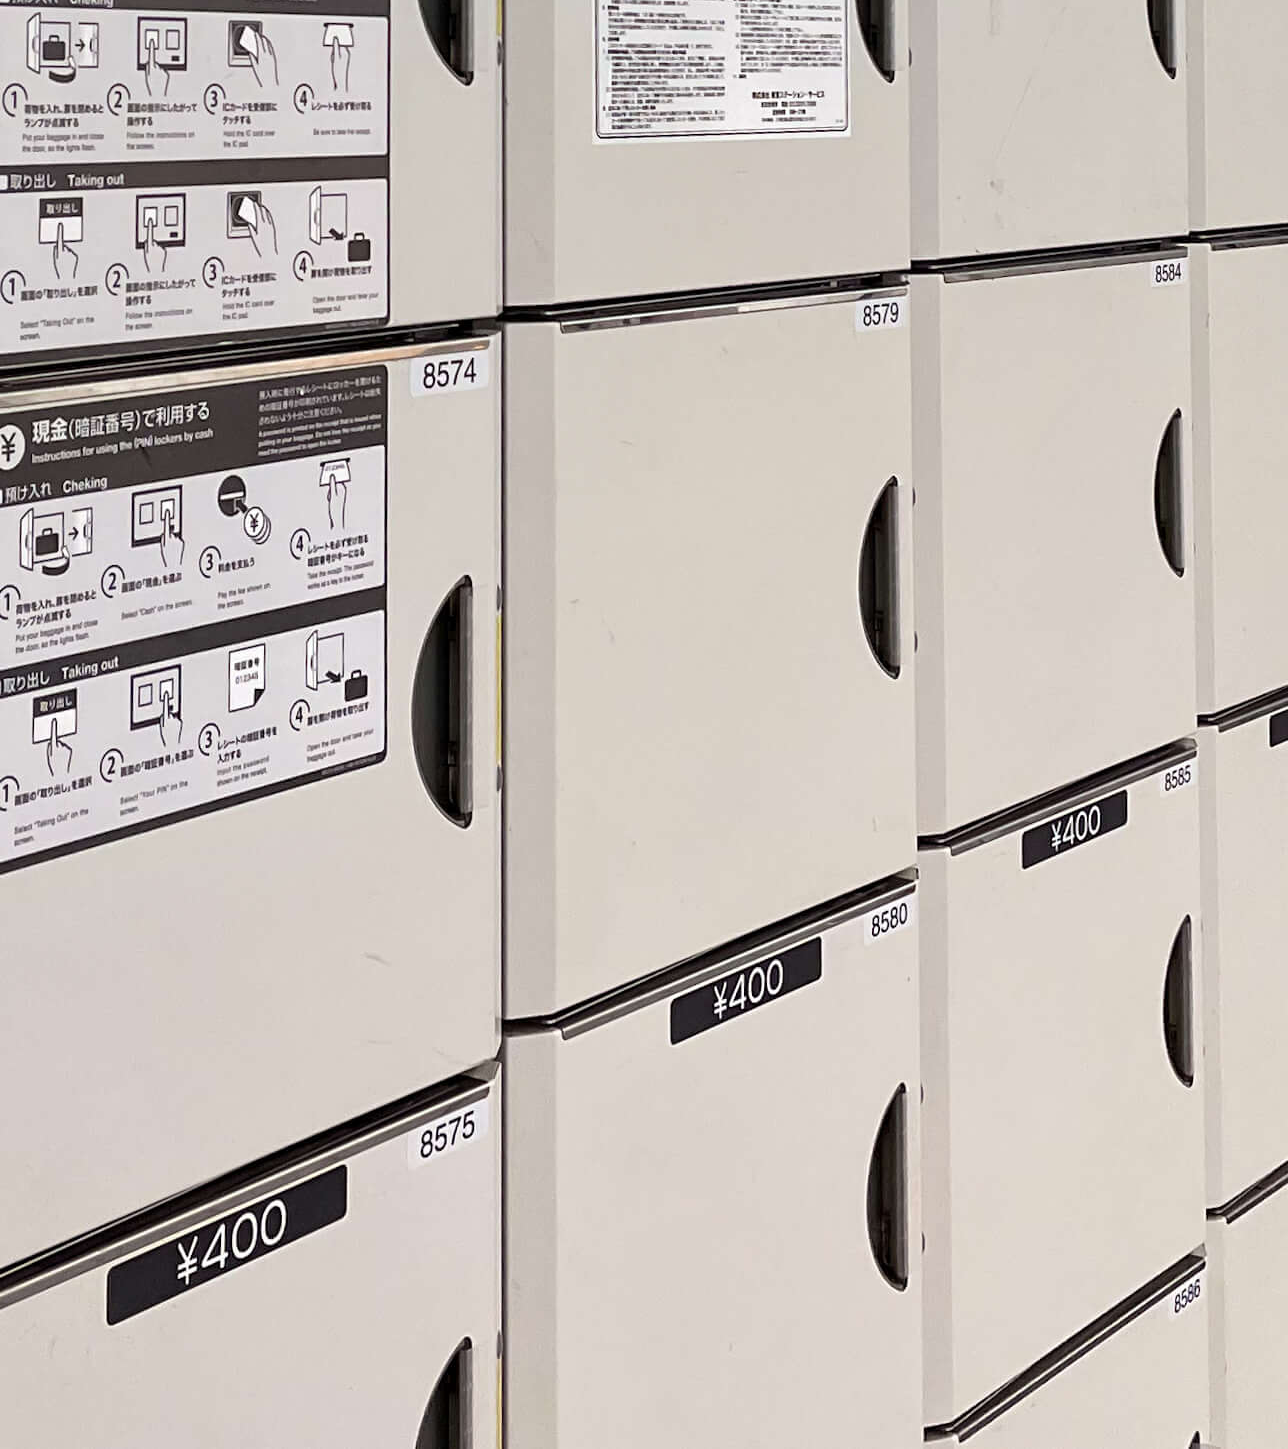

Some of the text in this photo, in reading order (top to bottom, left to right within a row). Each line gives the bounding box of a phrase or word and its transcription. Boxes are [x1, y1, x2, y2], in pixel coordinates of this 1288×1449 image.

[10, 173, 125, 190] 取り出し Taking out
[1154, 262, 1183, 284] 8584
[861, 302, 901, 328] 8579
[422, 357, 477, 390] 8574
[62, 476, 107, 494] Cheking
[1164, 764, 1192, 791] 8585
[1050, 804, 1102, 852] ¥400
[871, 902, 908, 937] 8580
[713, 959, 784, 1020] ¥400
[419, 1109, 477, 1160] 8575
[175, 1198, 288, 1286] ¥400
[1174, 1278, 1201, 1313] 8586
